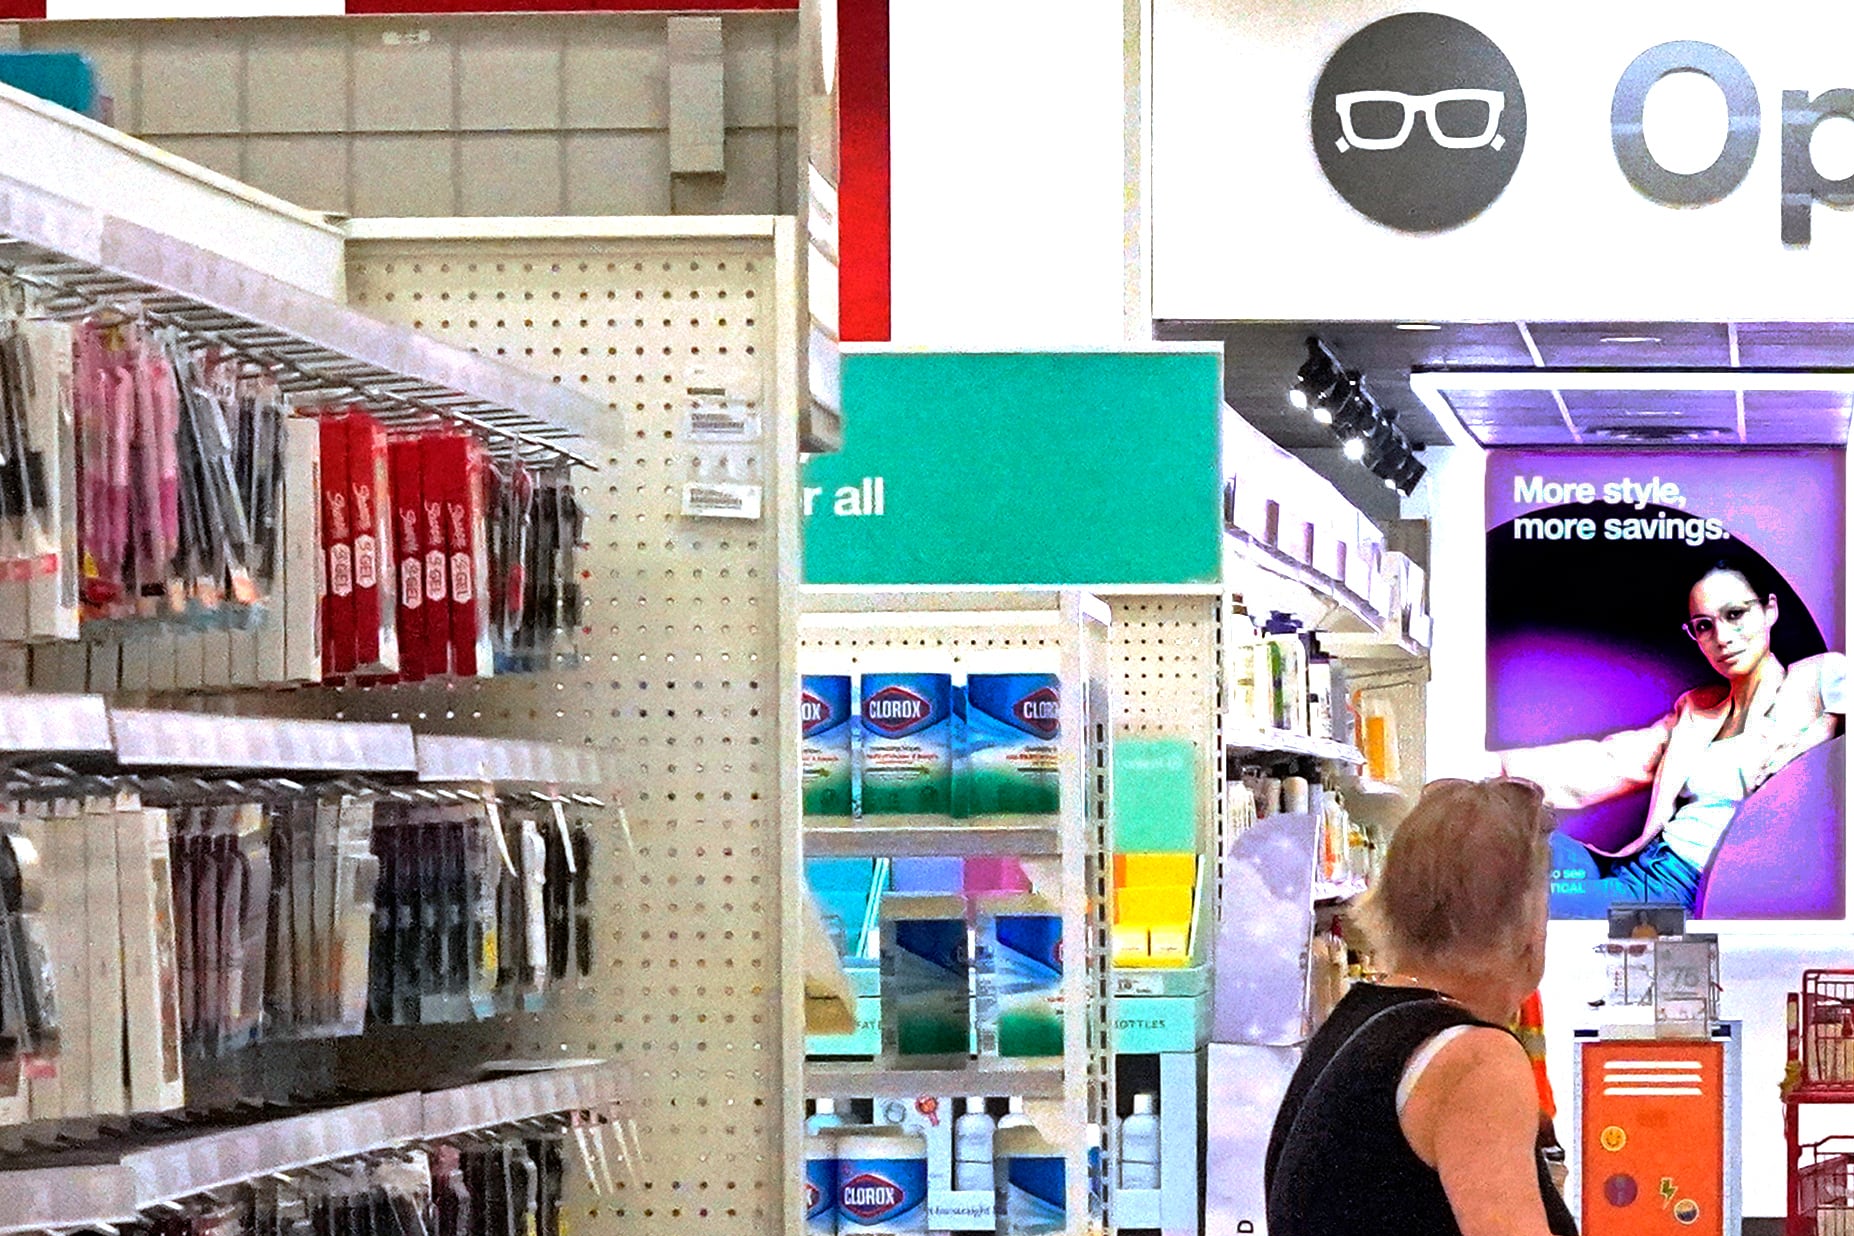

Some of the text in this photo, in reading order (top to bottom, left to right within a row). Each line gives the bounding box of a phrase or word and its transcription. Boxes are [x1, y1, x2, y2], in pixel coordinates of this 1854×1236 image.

[801, 477, 884, 516] r all
[1514, 475, 1687, 508] More style,
[1514, 515, 1731, 546] more savings.
[870, 699, 921, 718] CLOROX
[1550, 884, 1586, 894] TICAL
[844, 1186, 895, 1206] CLOROX
